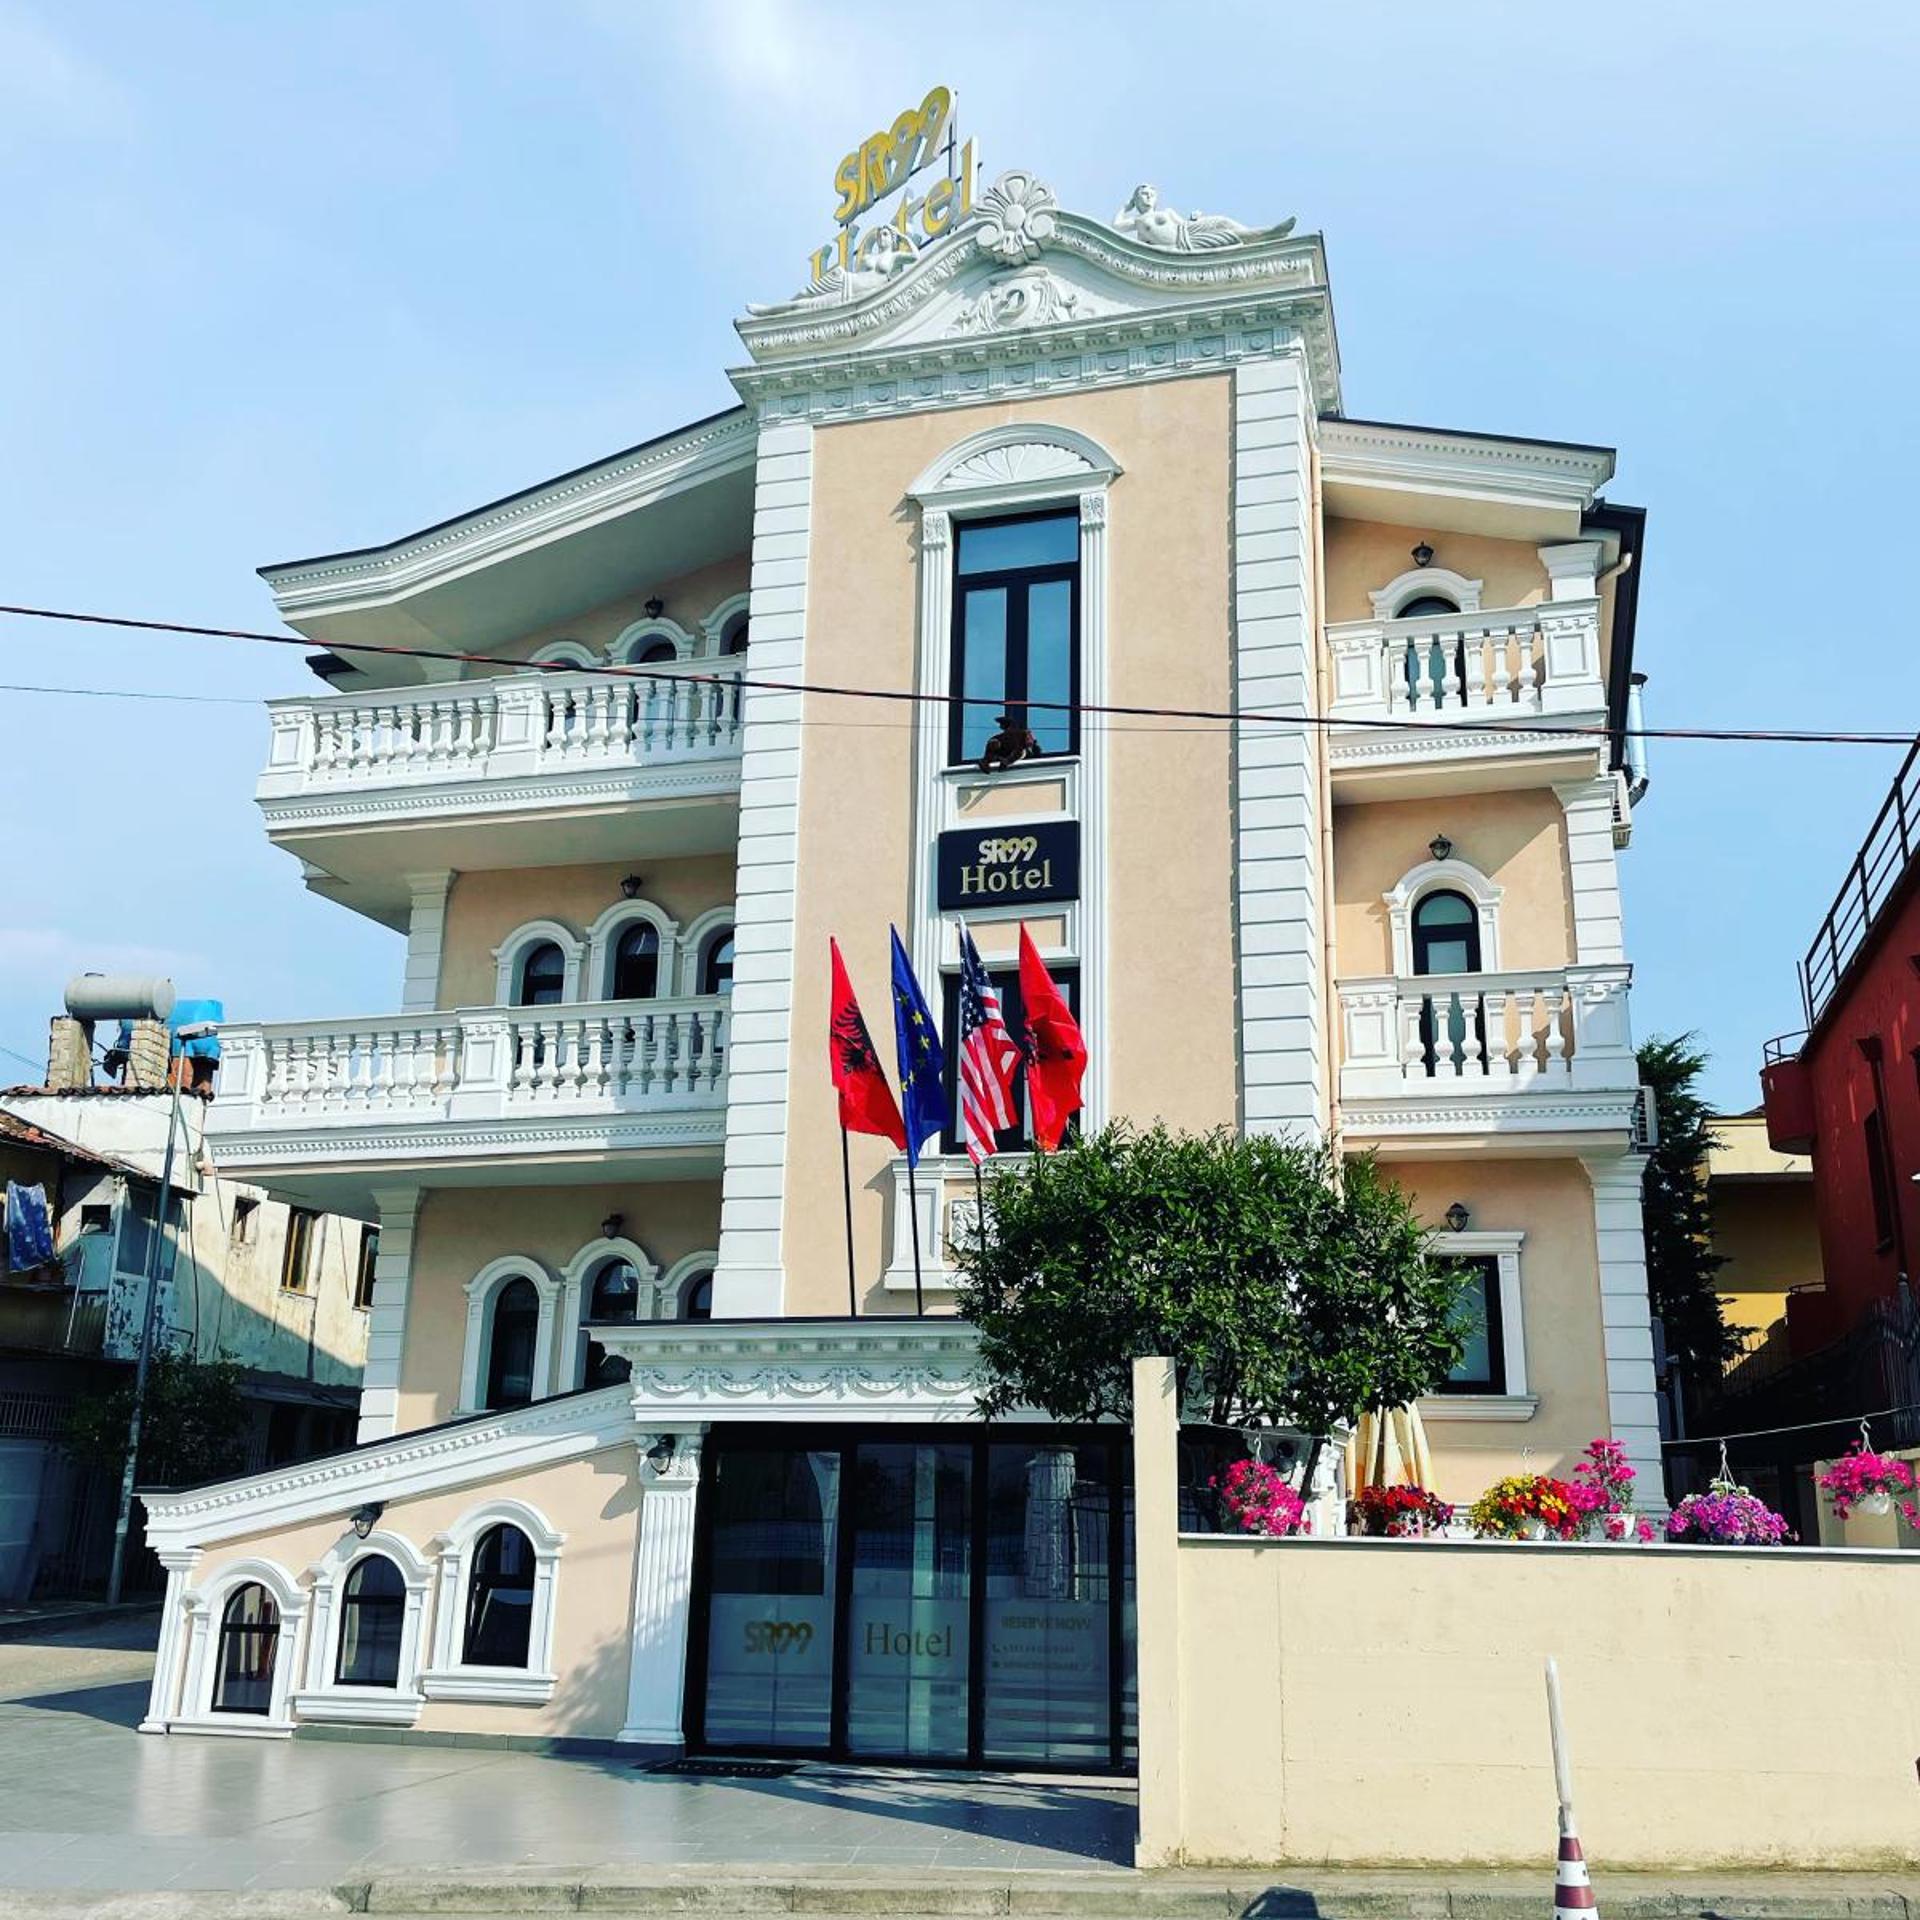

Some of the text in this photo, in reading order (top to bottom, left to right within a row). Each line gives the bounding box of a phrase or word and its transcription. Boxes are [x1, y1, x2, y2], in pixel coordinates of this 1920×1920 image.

[834, 86, 956, 224] SR99
[978, 836, 1038, 864] SR99
[960, 859, 1053, 895] Hotel
[744, 1620, 953, 1658] SR99 Hotel
[1055, 1616, 1091, 1630] NOW
